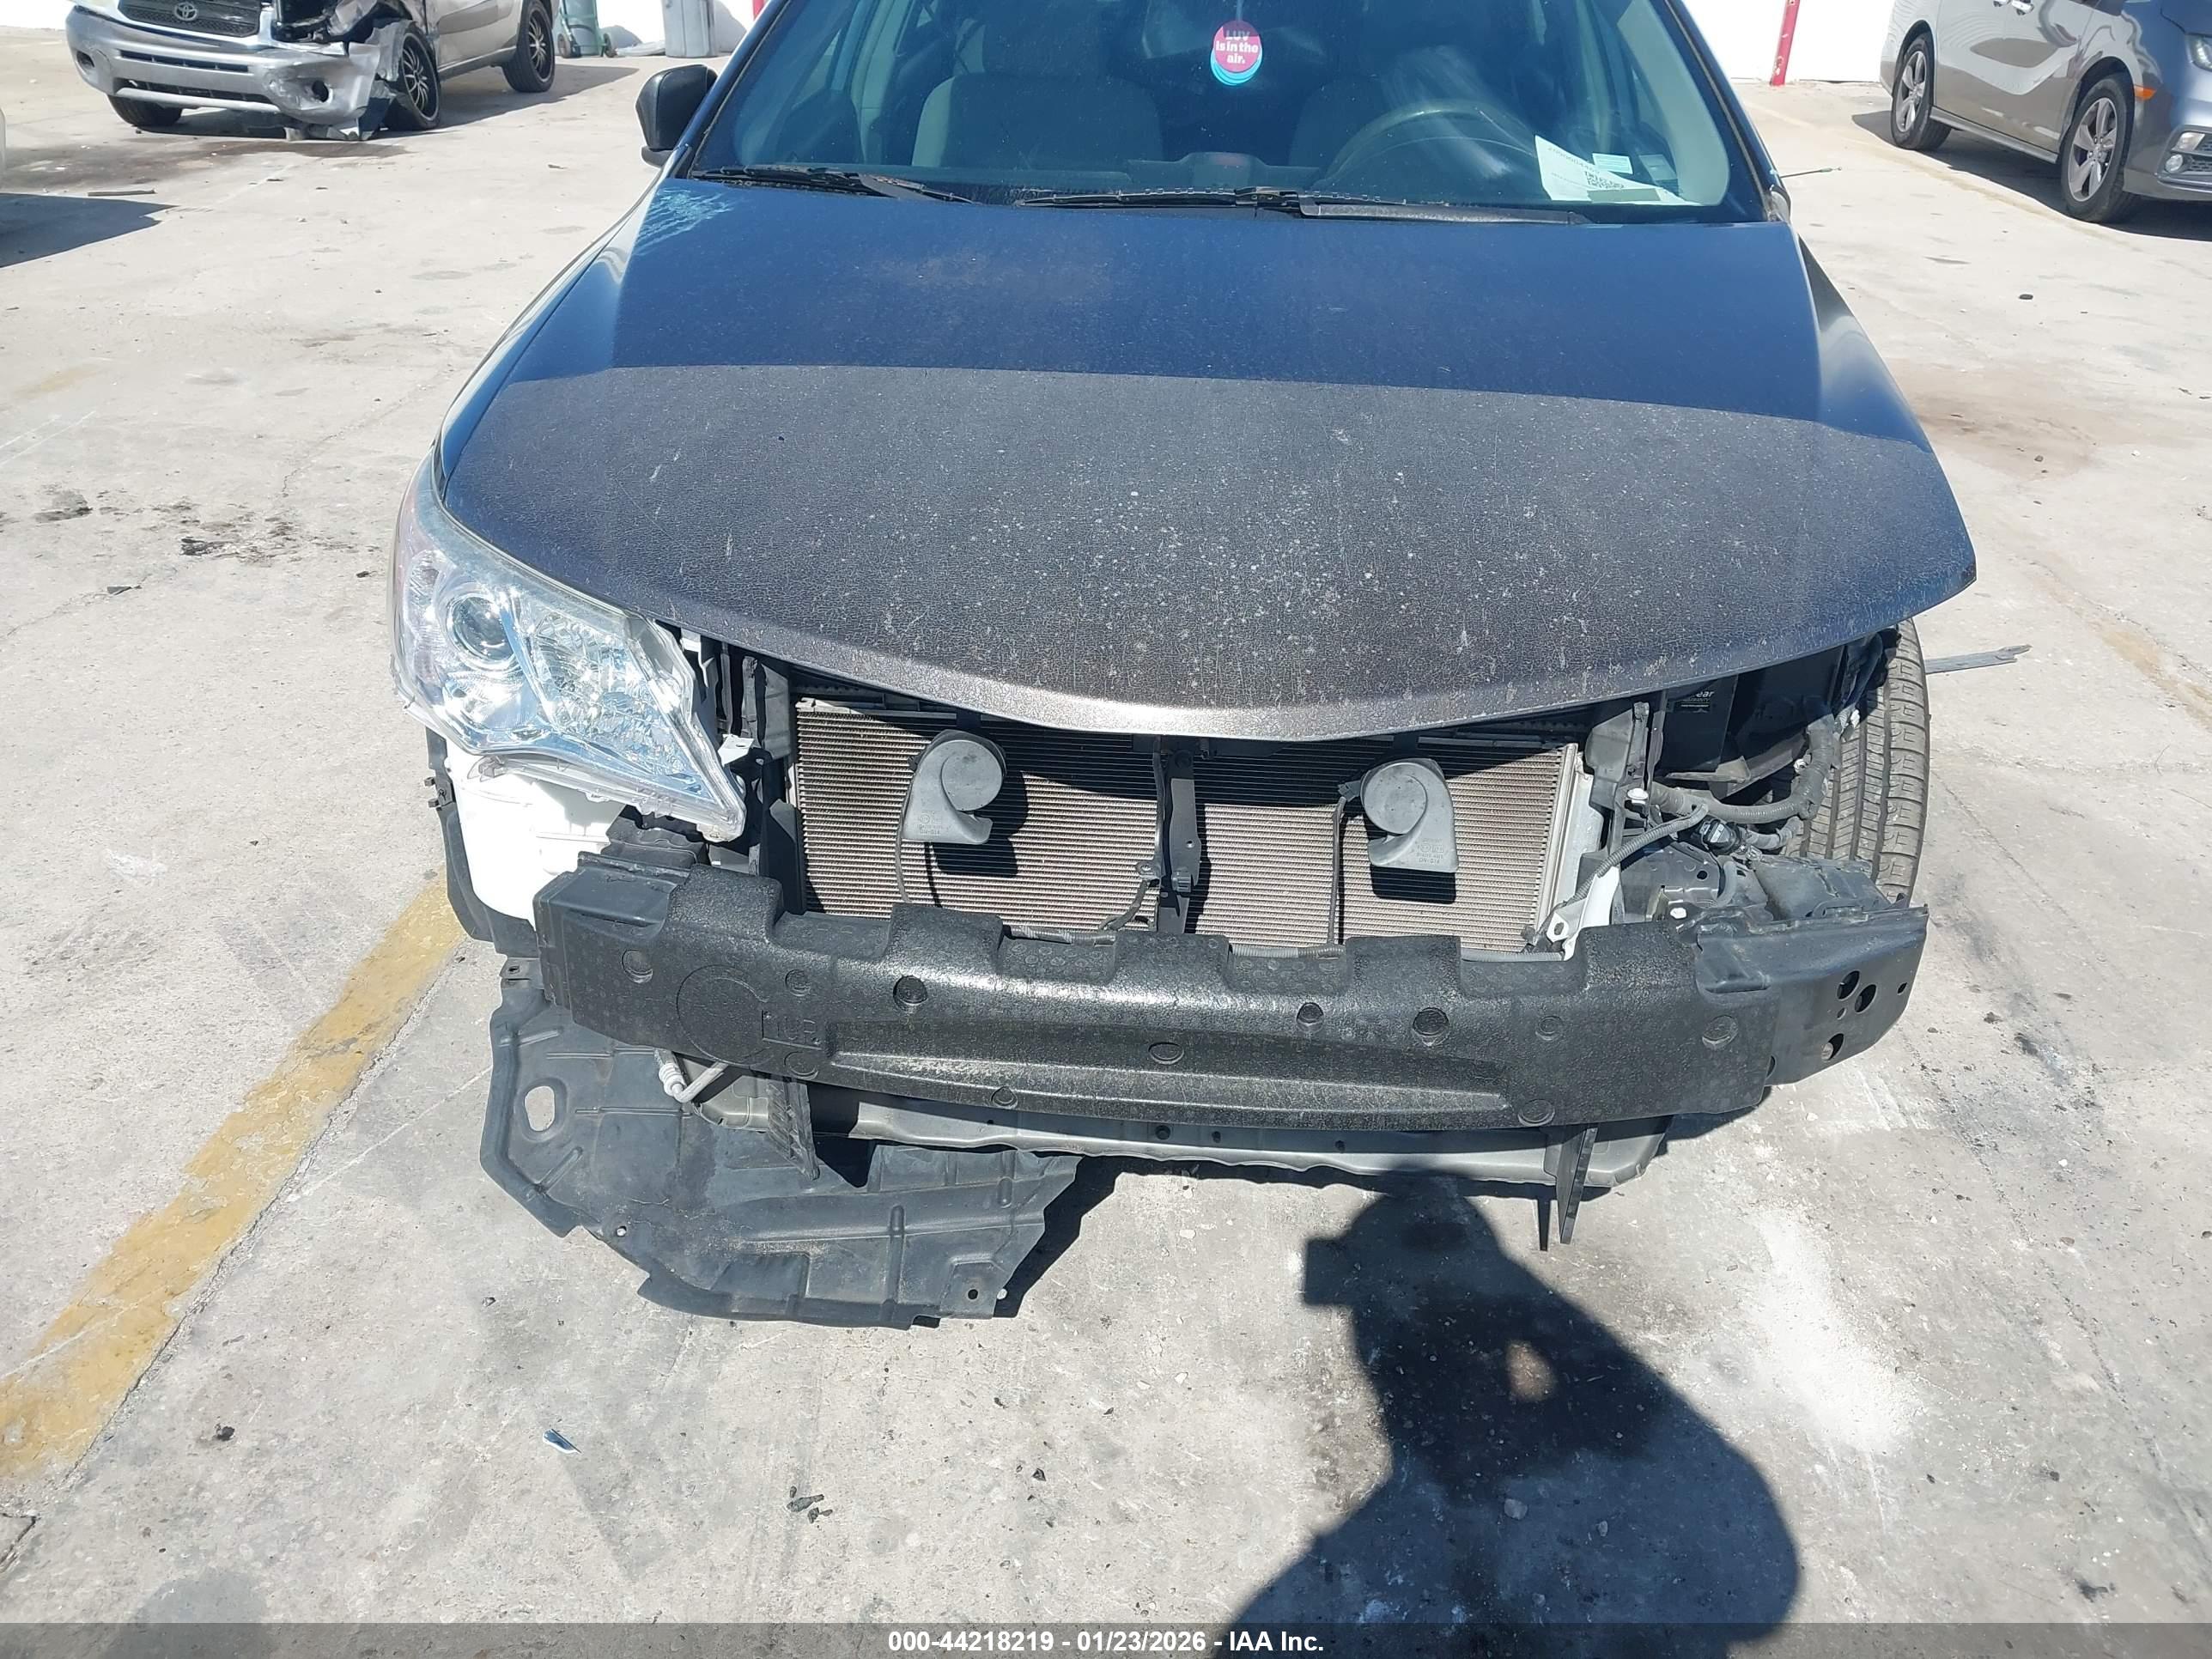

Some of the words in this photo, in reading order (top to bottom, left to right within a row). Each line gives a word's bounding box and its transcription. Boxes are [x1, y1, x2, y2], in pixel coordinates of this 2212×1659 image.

[1225, 30, 1249, 40] LUV
[1215, 40, 1225, 51] is
[1226, 41, 1237, 52] in
[1238, 42, 1258, 52] the
[1226, 53, 1245, 64] air.
